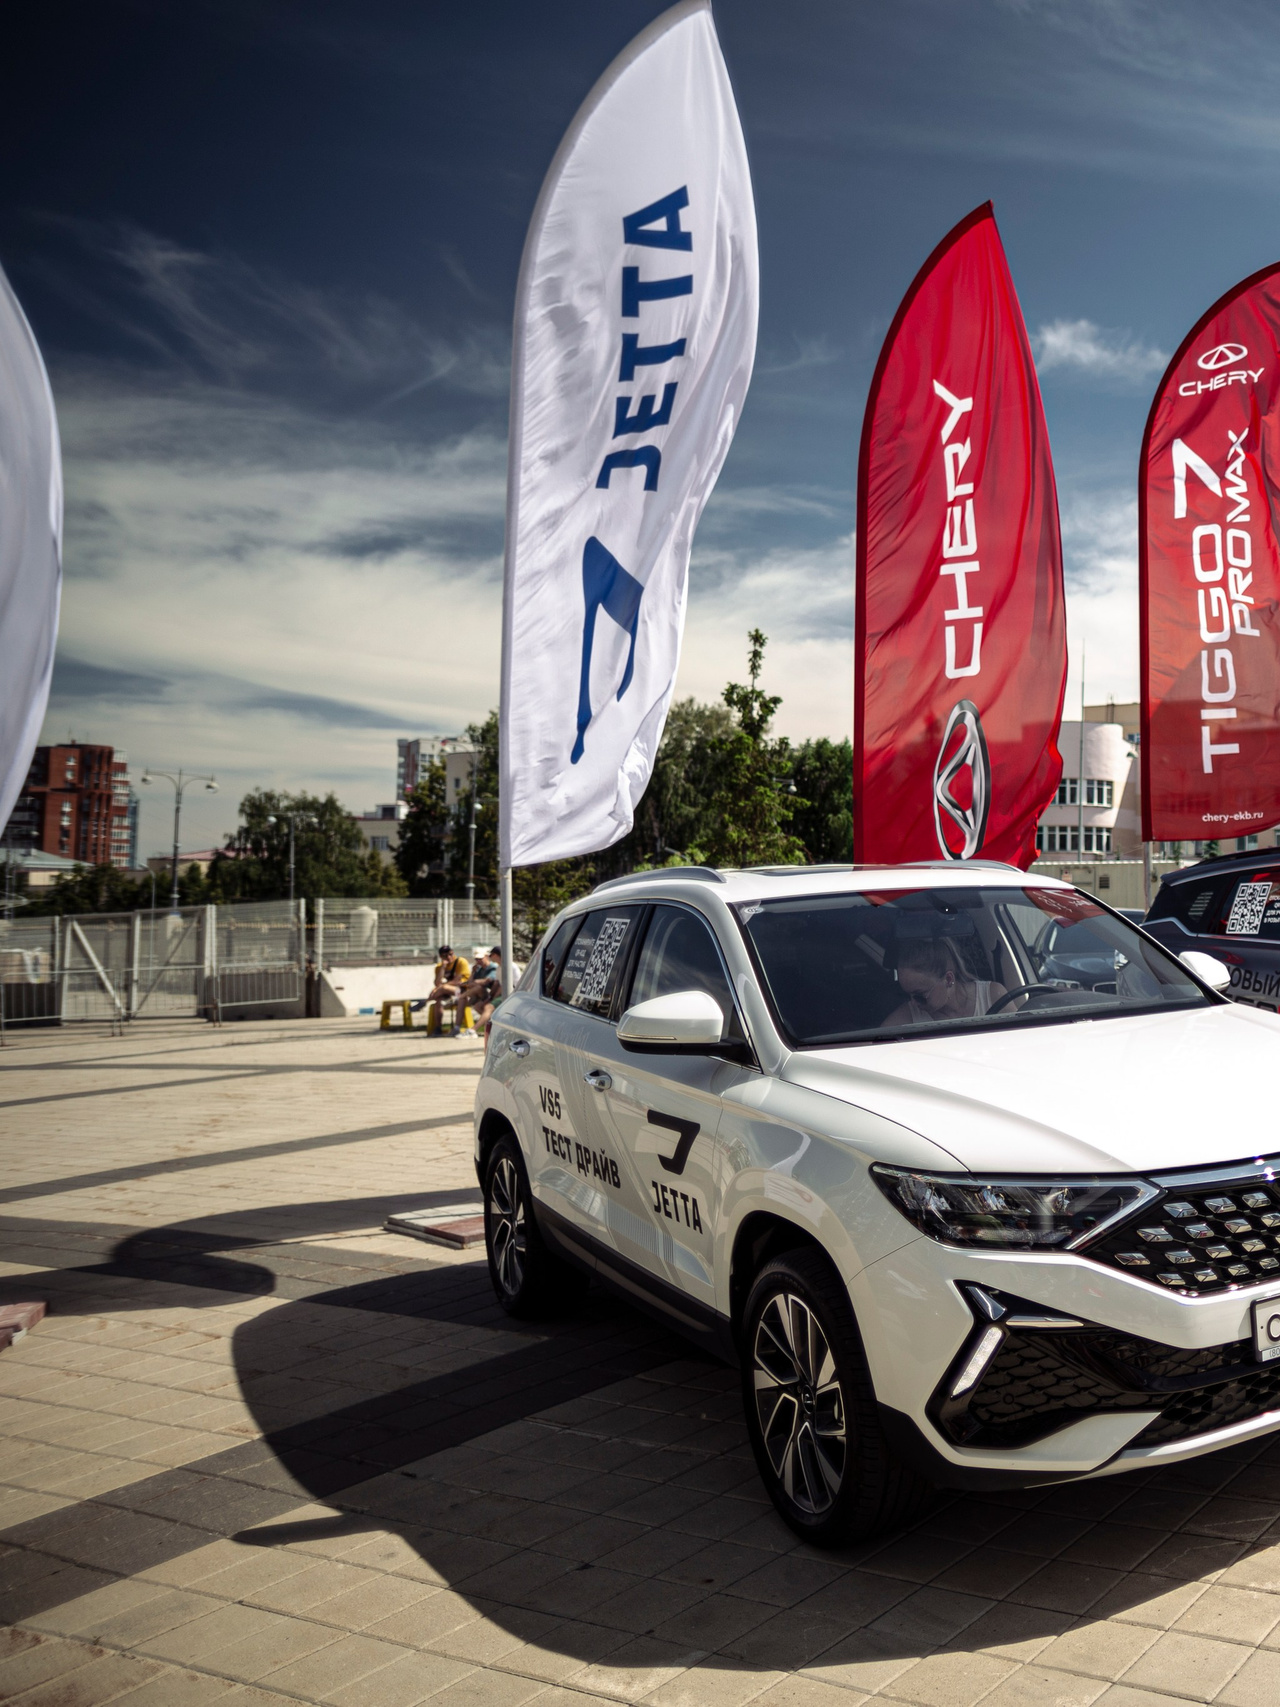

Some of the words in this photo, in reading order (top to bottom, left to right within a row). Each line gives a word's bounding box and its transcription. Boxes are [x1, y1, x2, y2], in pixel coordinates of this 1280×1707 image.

[595, 185, 694, 492] JETTA
[1178, 367, 1265, 398] CHERY
[1171, 438, 1223, 519] 7
[932, 378, 984, 680] CHERY
[1192, 523, 1240, 774] TIGGO
[1201, 810, 1264, 824] chery-ekb.ru
[538, 1085, 562, 1121] VS5
[542, 1126, 573, 1167] ТЕСТ
[575, 1141, 622, 1190] ДРАЙВ
[651, 1180, 704, 1236] JETTA
